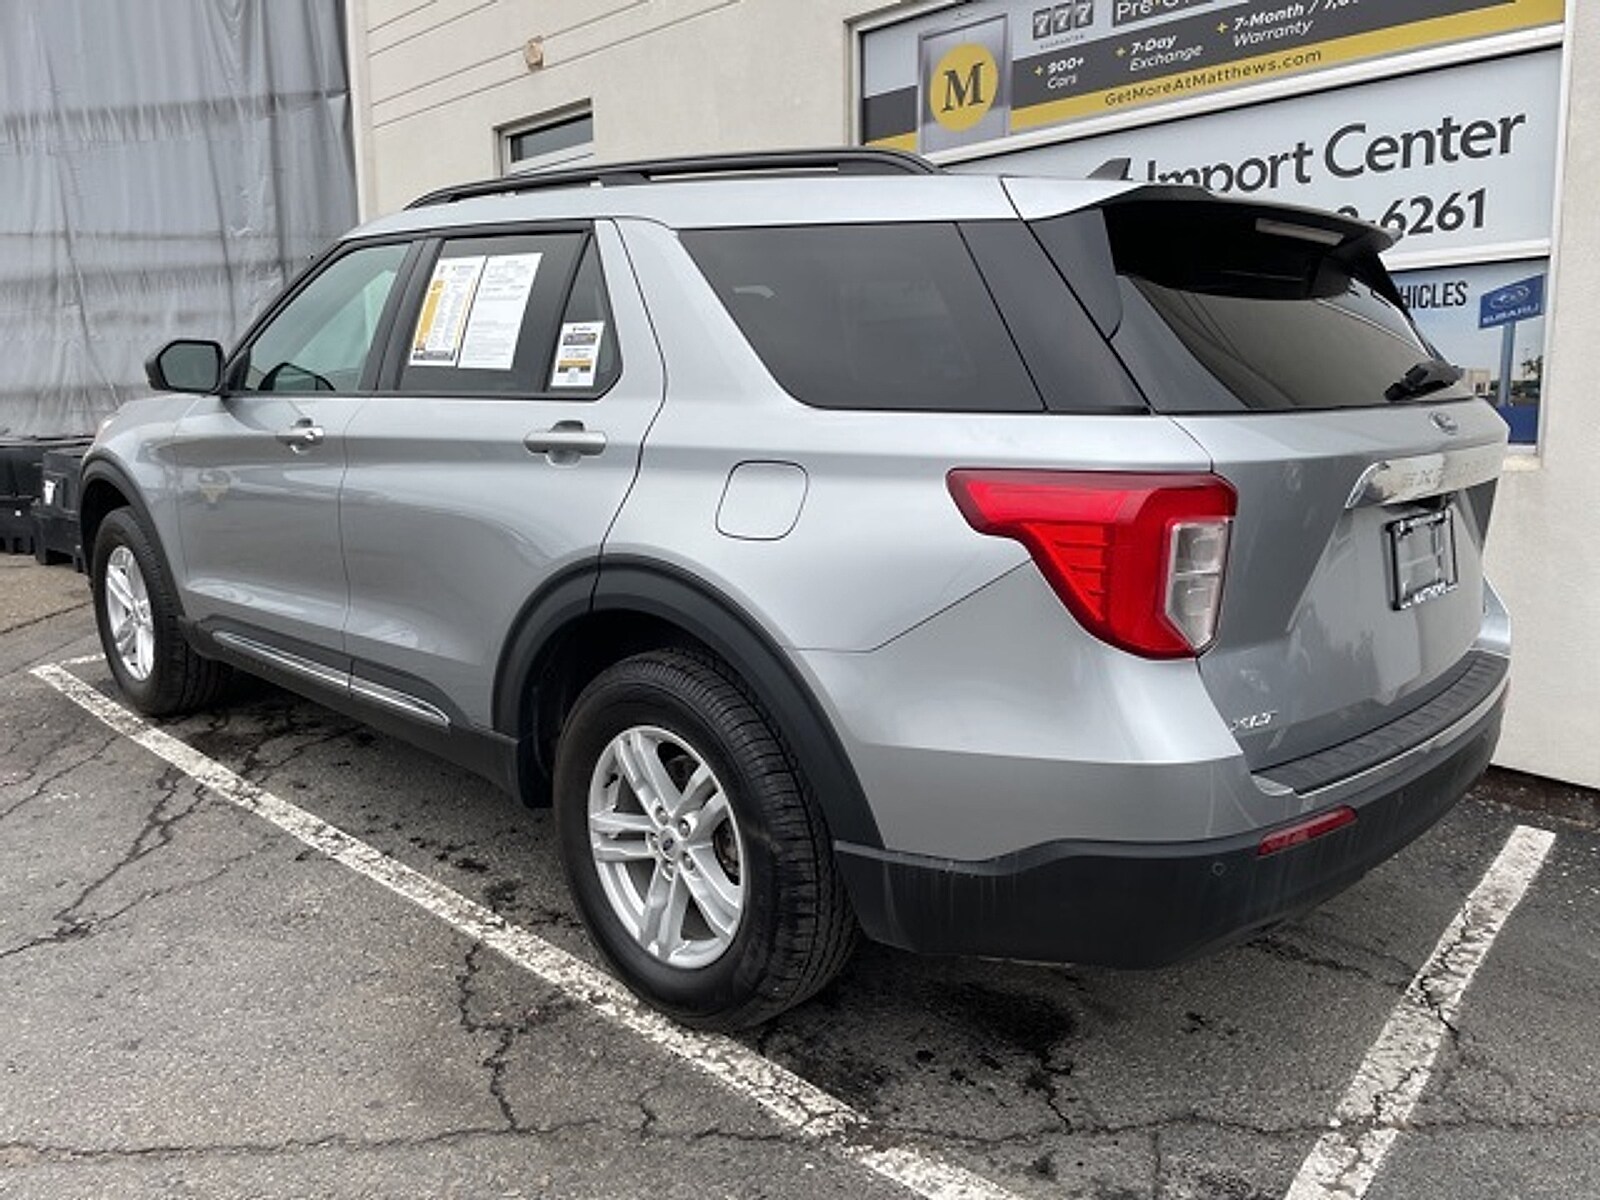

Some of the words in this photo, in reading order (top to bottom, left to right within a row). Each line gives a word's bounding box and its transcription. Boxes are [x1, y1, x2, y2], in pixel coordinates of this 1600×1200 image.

[1233, 2, 1304, 31] 7-Month
[1130, 35, 1177, 55] 7-Day
[1233, 20, 1314, 47] Warranty
[1130, 44, 1203, 71] Exchange
[940, 61, 985, 112] M
[1047, 75, 1077, 89] Cars
[1105, 50, 1322, 106] GetMoreAtMatthews.com
[1324, 112, 1526, 179] Center
